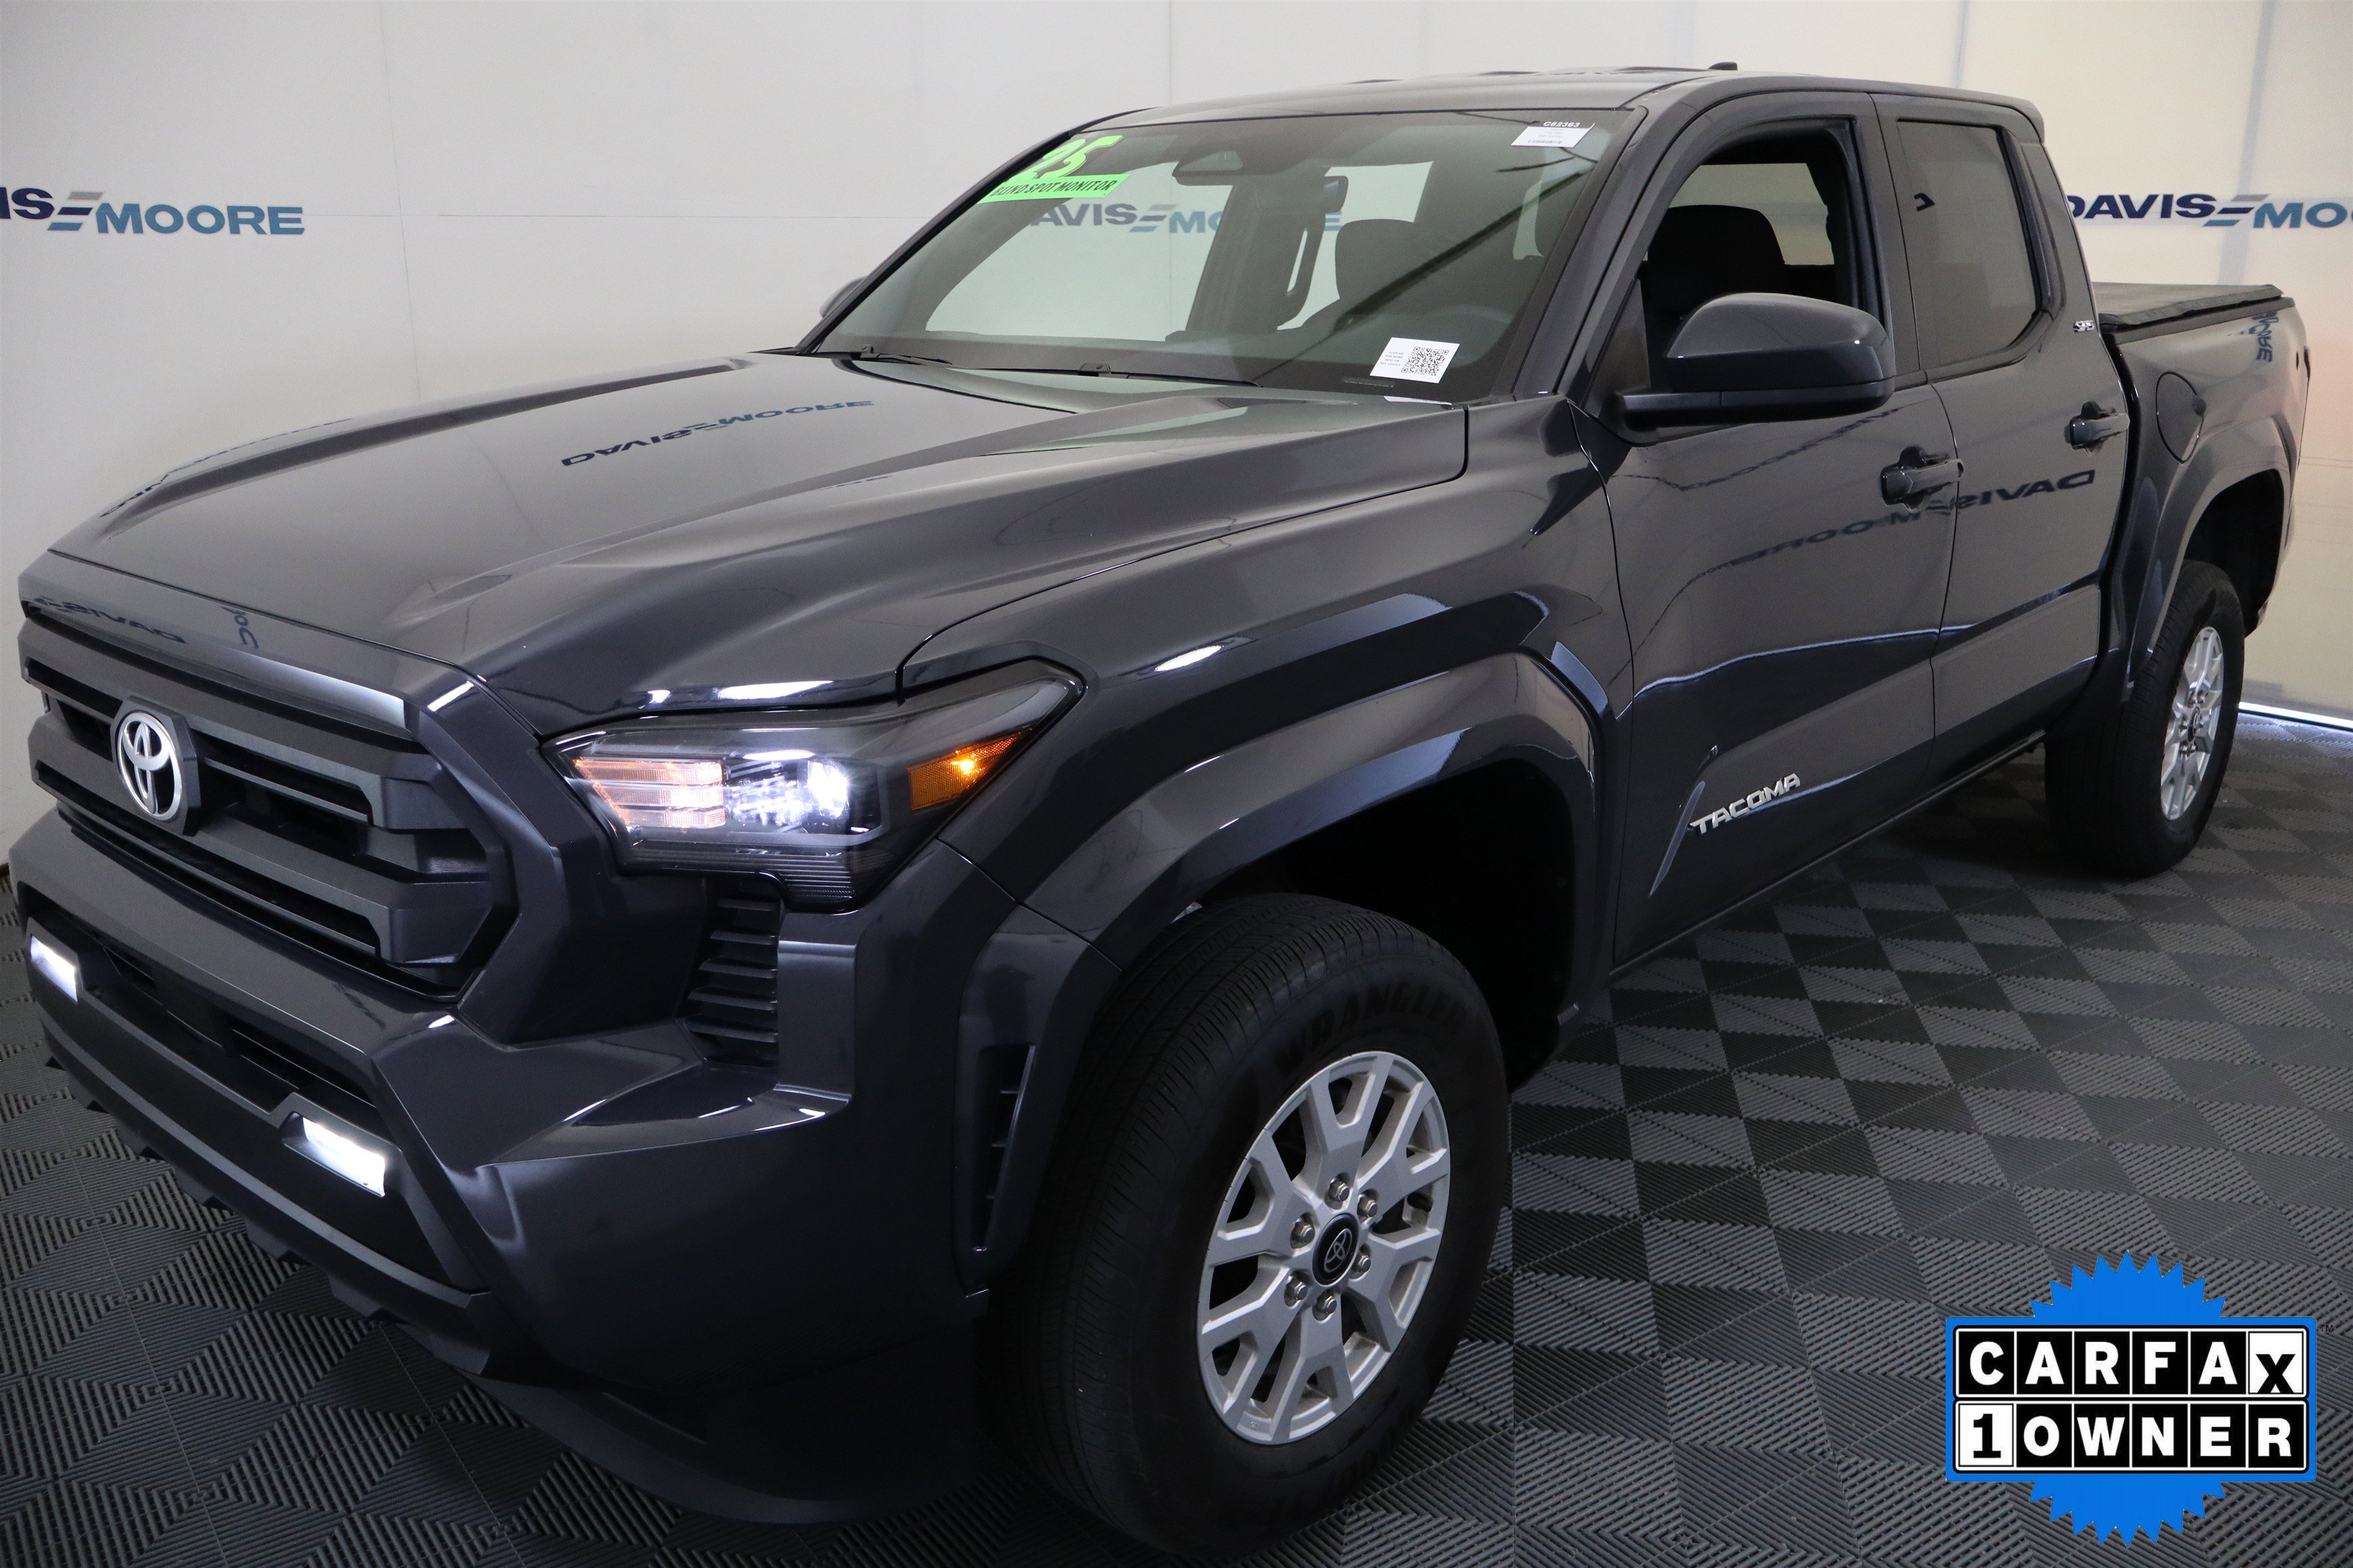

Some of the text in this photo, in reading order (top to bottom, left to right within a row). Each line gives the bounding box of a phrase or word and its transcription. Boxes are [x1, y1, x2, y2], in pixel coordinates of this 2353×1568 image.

[989, 180, 1118, 197] BLIND SPOT MONITOR
[95, 202, 305, 235] MOORE
[1030, 203, 1138, 226] AVIS
[2066, 193, 2353, 228] DAVIS MO
[1689, 773, 1802, 835] TACOMA
